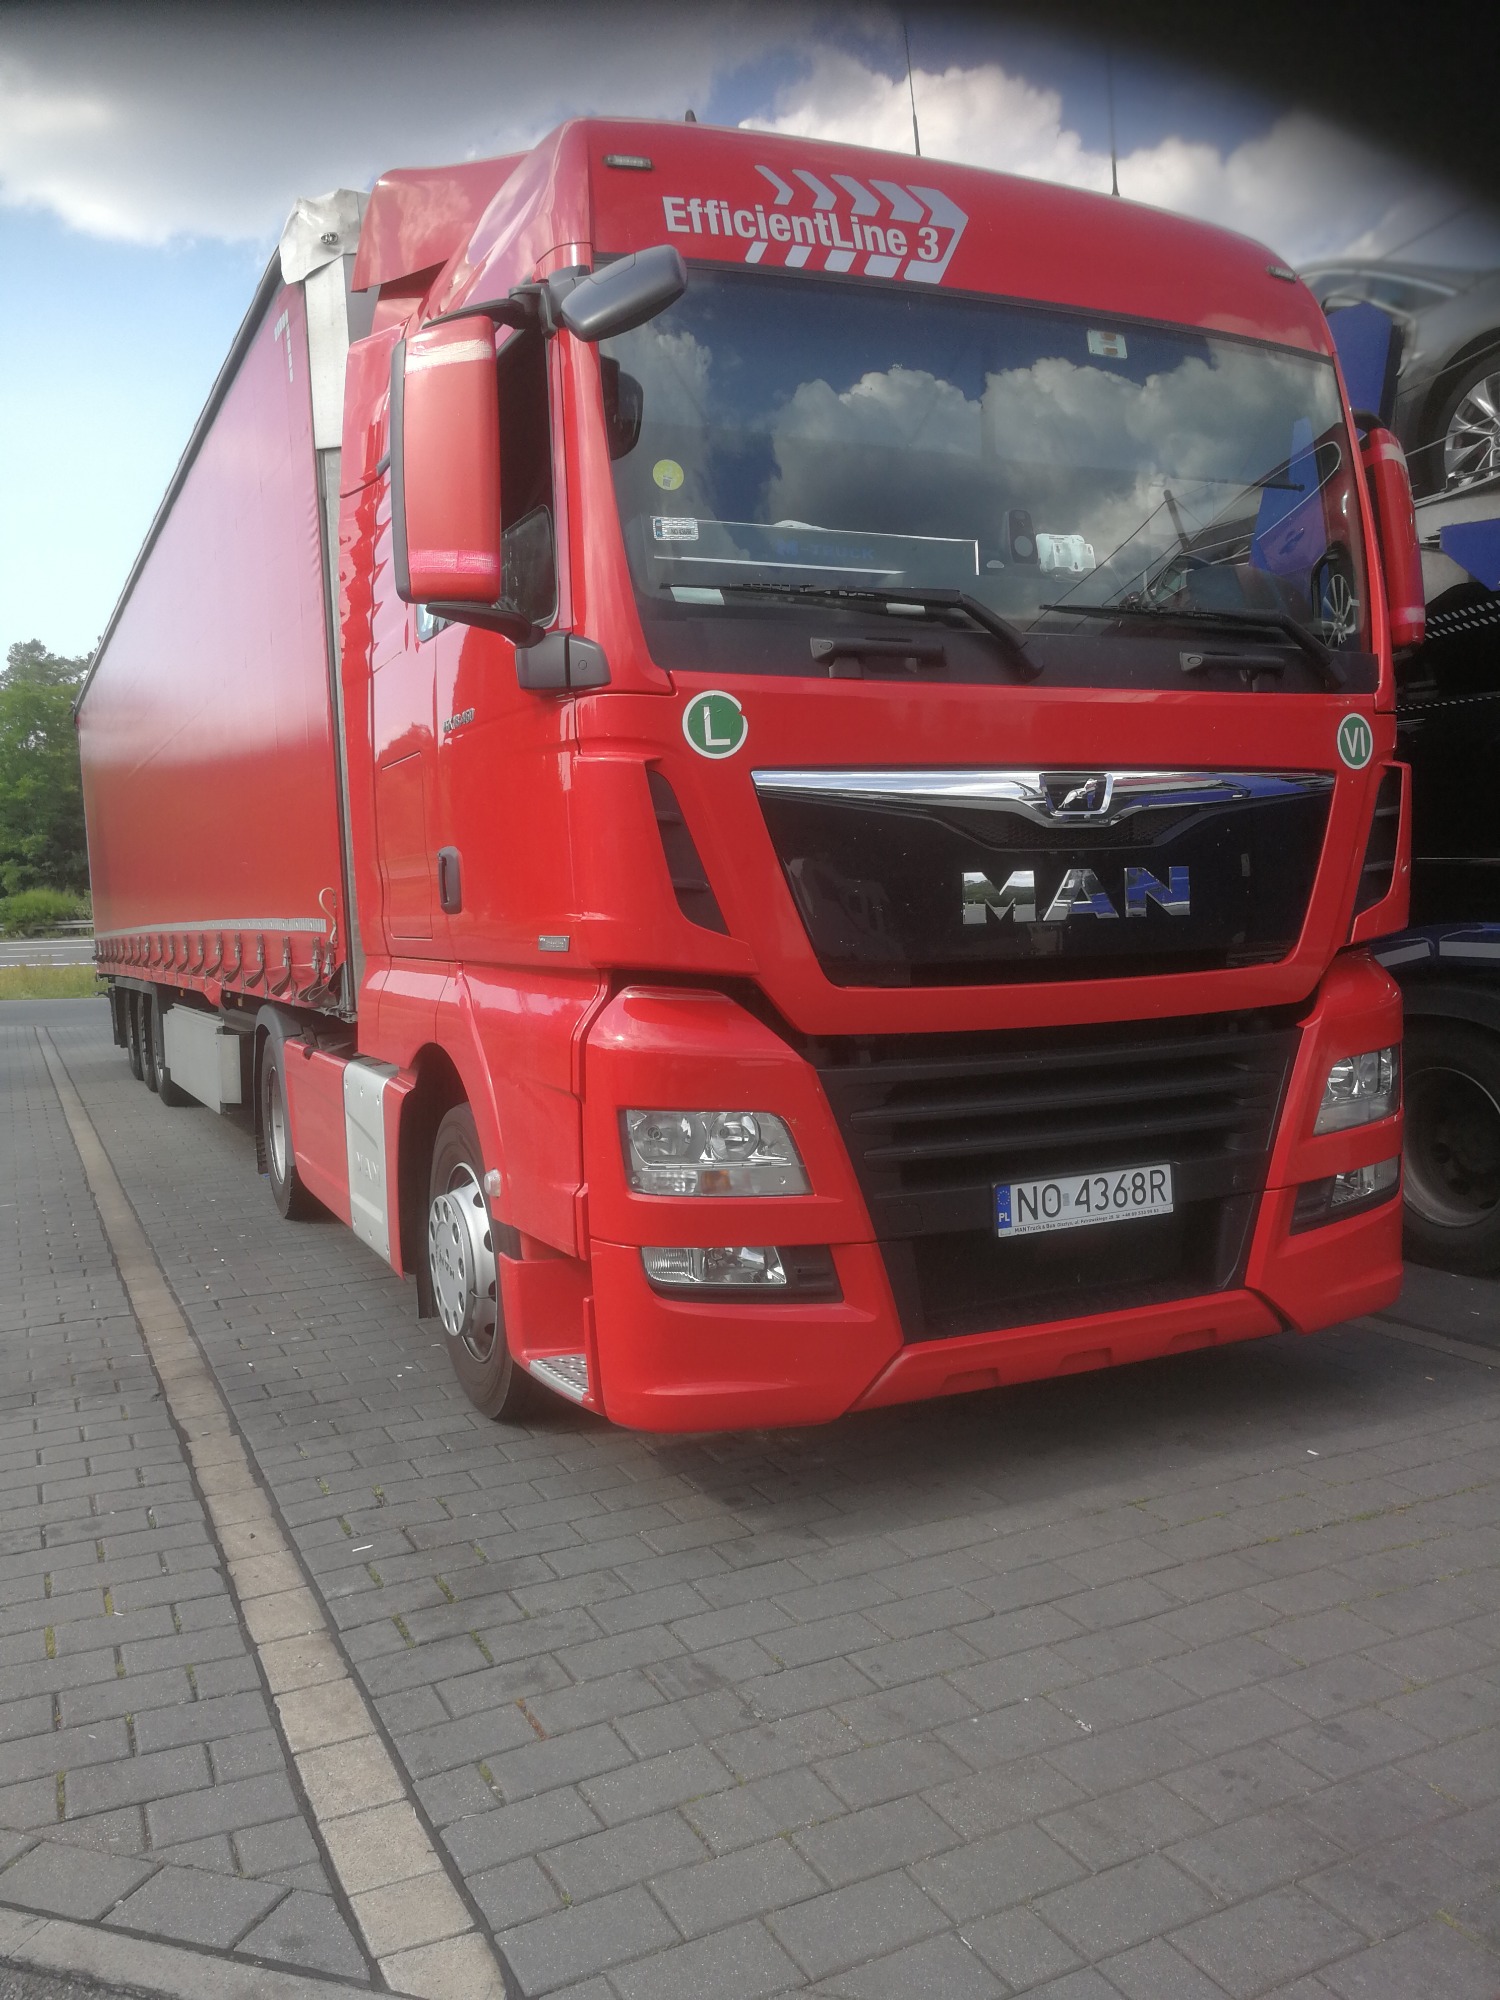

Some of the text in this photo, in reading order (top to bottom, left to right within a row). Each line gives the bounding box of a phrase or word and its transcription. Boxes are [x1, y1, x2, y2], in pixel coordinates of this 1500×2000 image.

[662, 196, 939, 261] EfficientLine 3
[703, 706, 731, 746] L
[1343, 726, 1366, 758] VI
[962, 866, 1191, 924] MAN
[998, 1212, 1011, 1223] PL
[1017, 1170, 1167, 1222] NO 4368R
